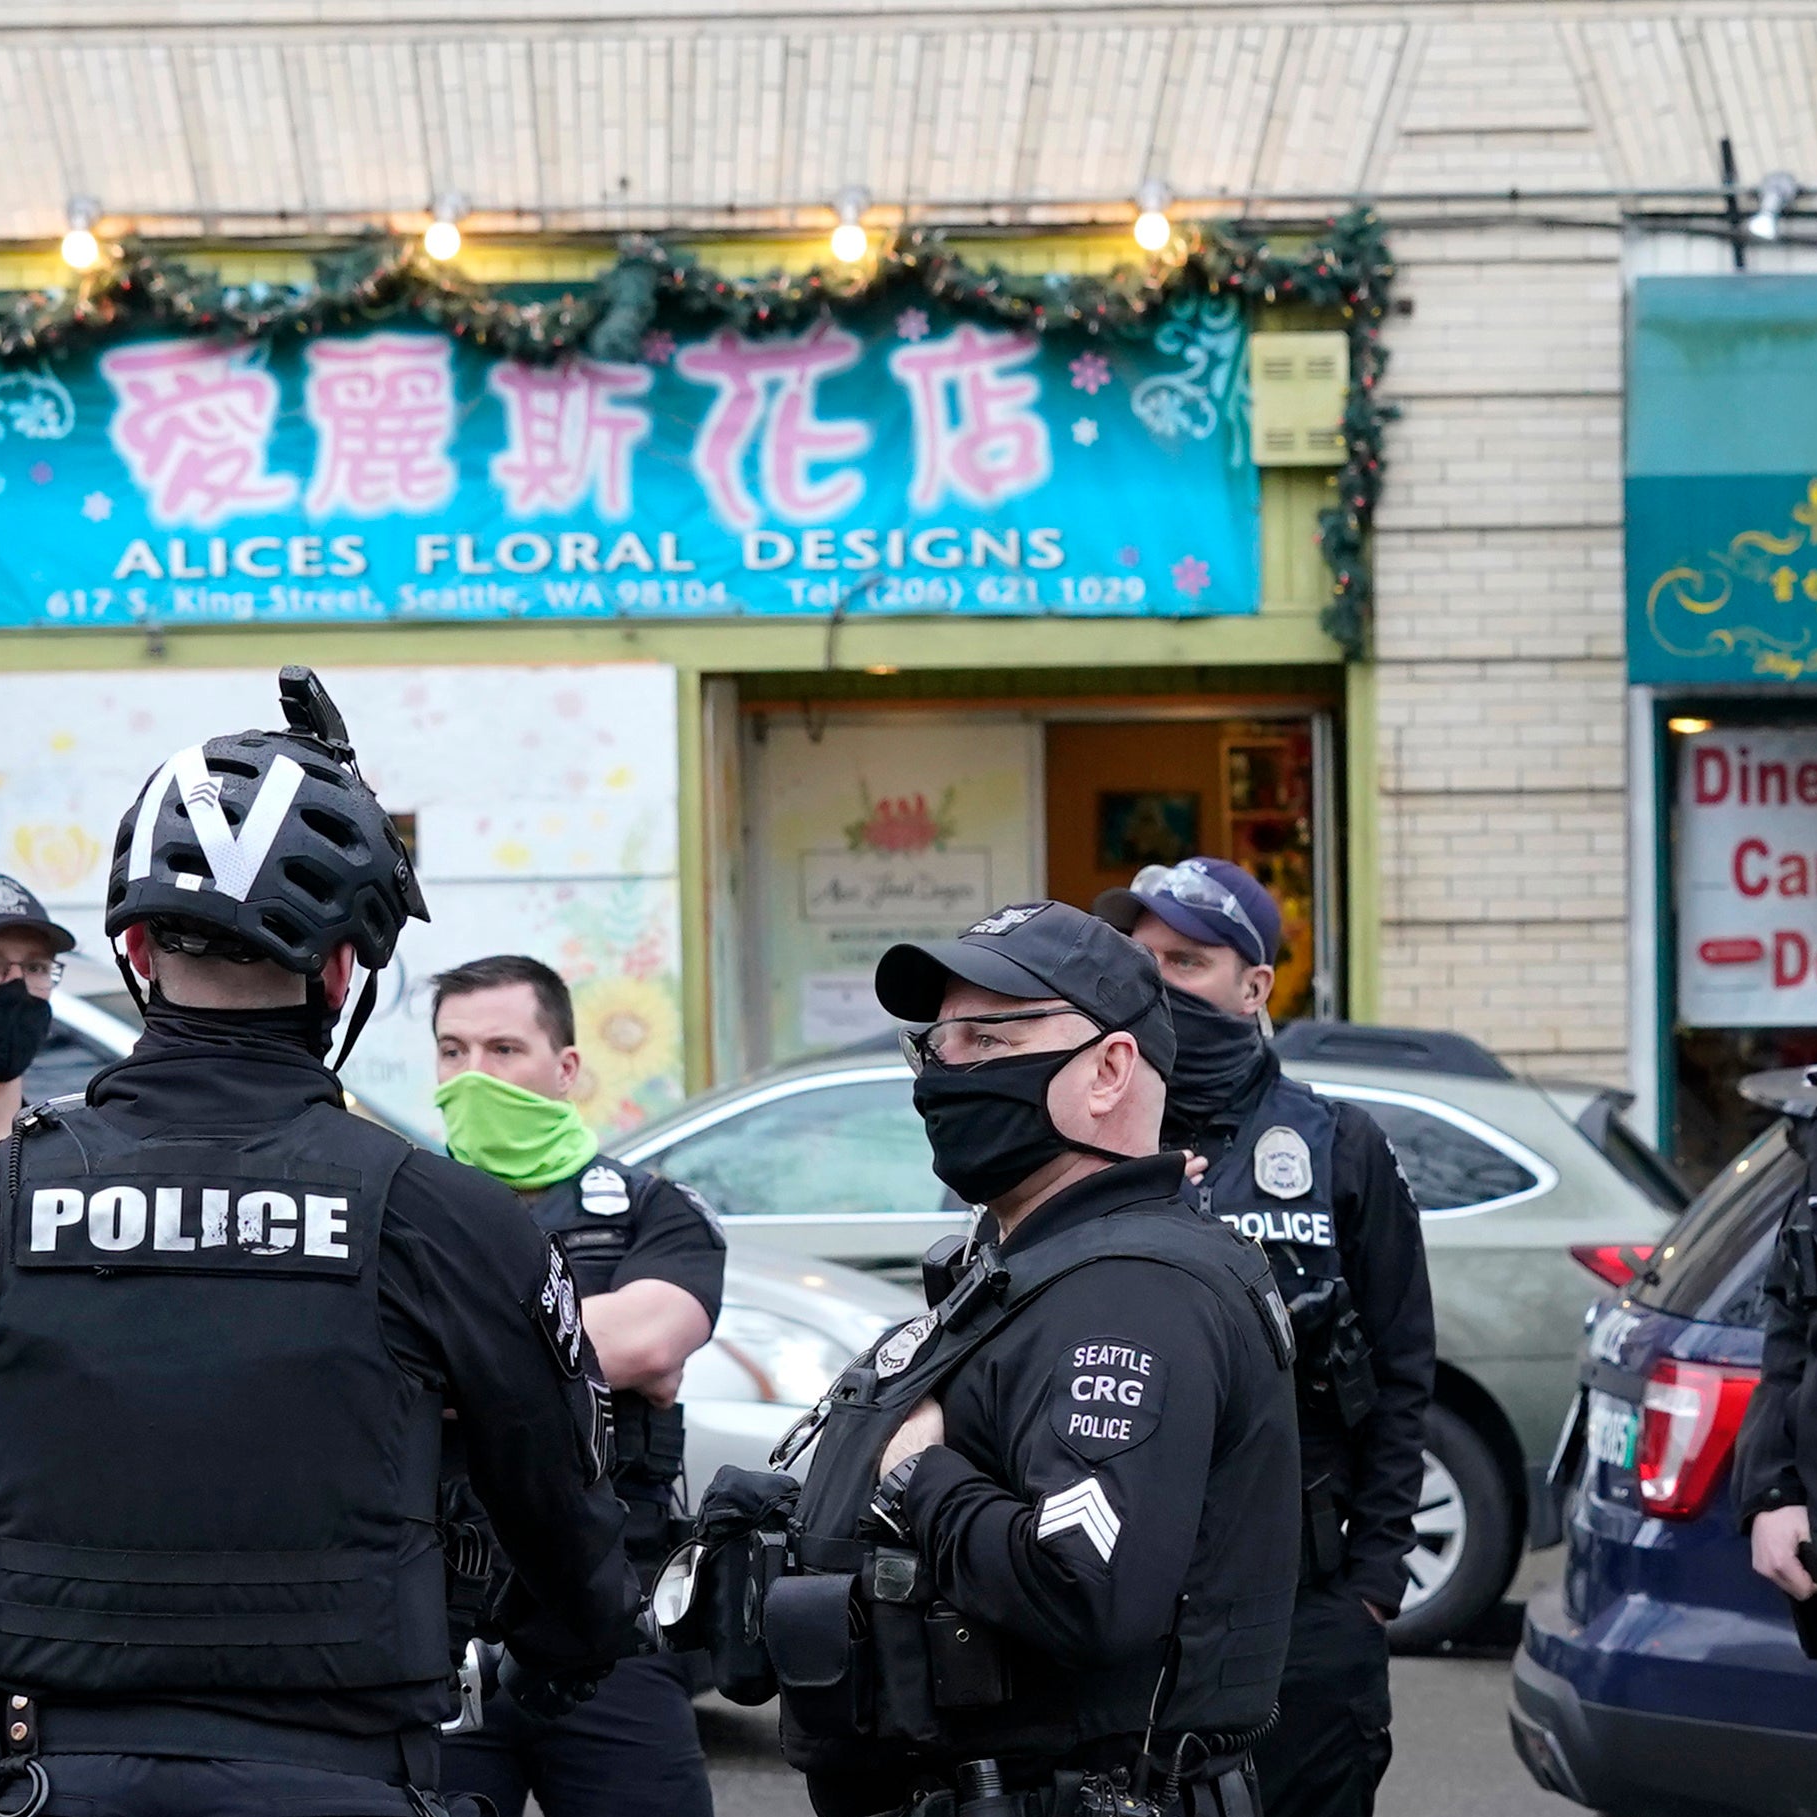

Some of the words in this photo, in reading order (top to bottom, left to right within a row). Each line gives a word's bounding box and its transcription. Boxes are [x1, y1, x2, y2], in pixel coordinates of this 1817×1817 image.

[98, 324, 1054, 530] 愛麗斯花店
[113, 534, 369, 580] ALICES
[415, 530, 695, 575] FLORAL
[741, 527, 1066, 572] DESIGNS
[45, 588, 112, 618] 617
[173, 586, 254, 621] King
[544, 581, 608, 609] WA
[615, 580, 728, 607] 98104
[976, 576, 1039, 605] 621
[1060, 576, 1147, 604] 1029
[30, 1185, 350, 1259] POLICE
[1072, 1345, 1153, 1377] SEATTLE
[1070, 1375, 1145, 1407] CRG
[1068, 1413, 1133, 1441] POLICE
